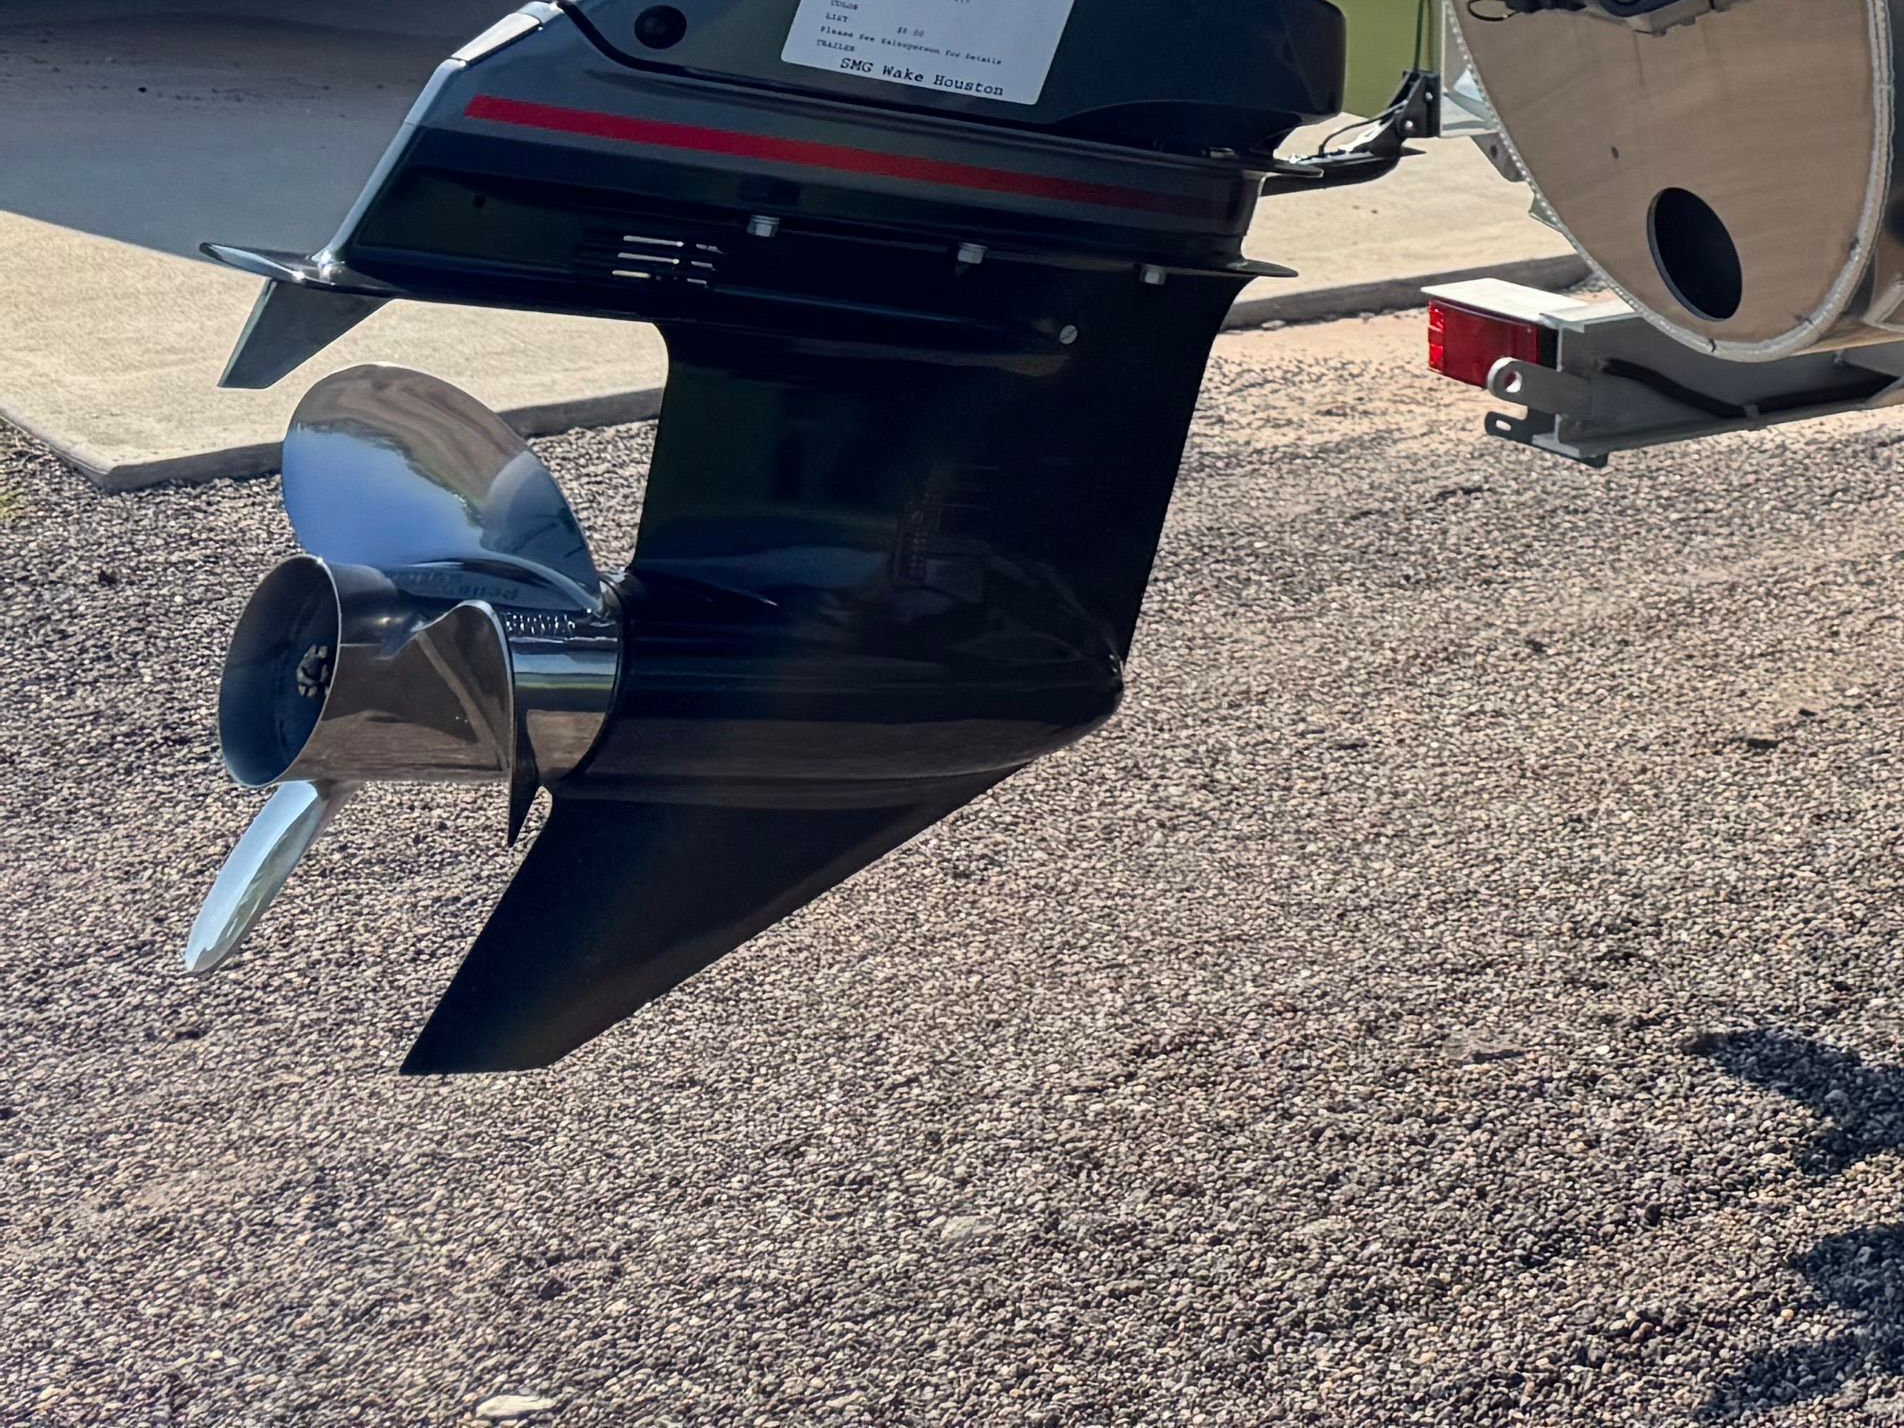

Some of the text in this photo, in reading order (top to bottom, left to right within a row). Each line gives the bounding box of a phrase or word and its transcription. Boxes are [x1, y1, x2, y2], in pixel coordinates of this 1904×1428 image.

[840, 58, 1003, 96] SMG Wake Houston
